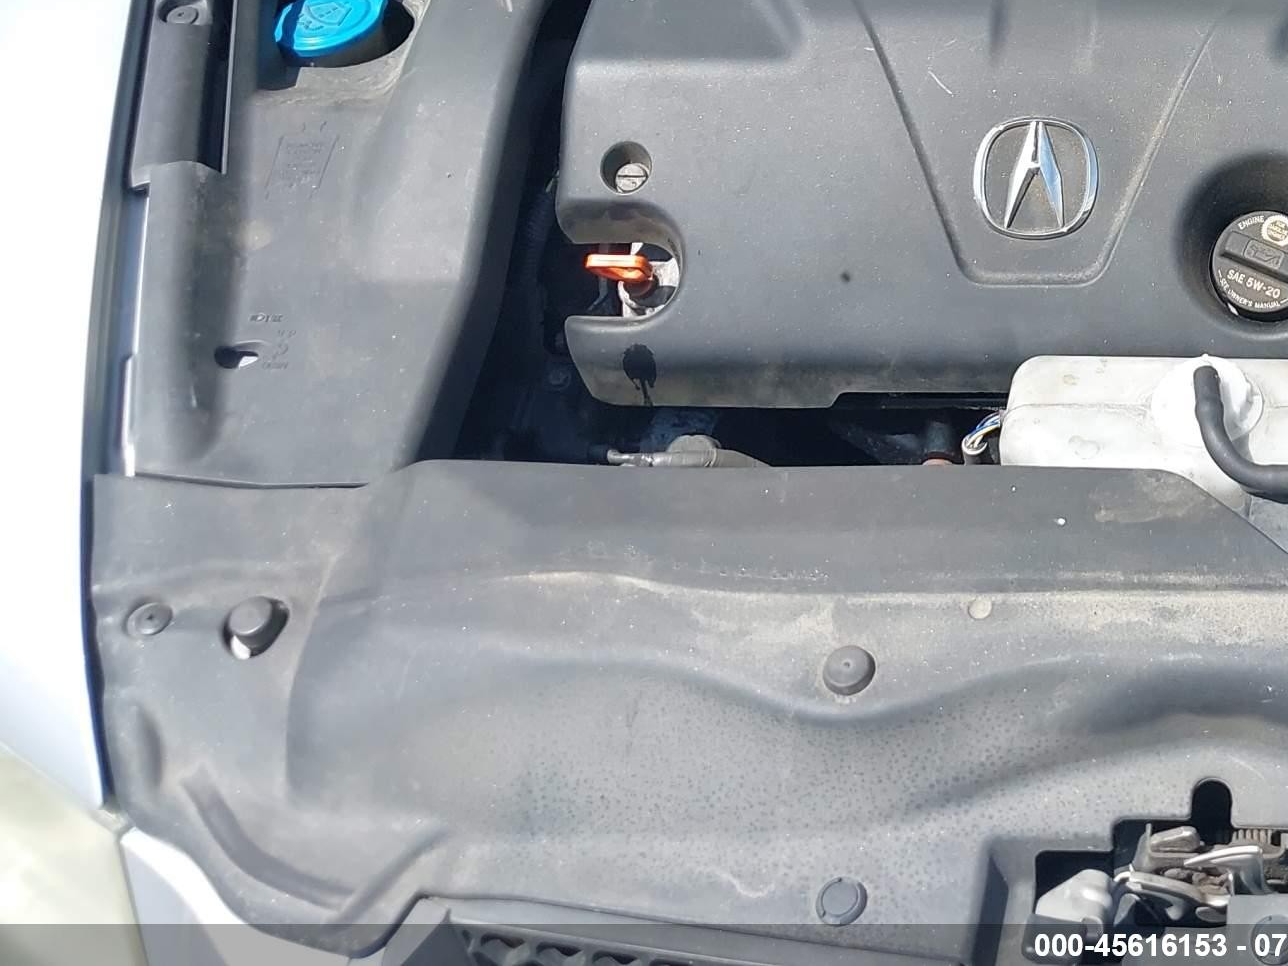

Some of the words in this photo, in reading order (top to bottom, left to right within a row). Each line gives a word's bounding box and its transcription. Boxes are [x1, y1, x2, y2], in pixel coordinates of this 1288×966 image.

[1238, 215, 1265, 230] ENGINE
[1227, 269, 1245, 284] SAE
[1246, 277, 1281, 298] 5W-20
[1228, 289, 1252, 307] OWNER'S
[1254, 300, 1280, 309] MANUAL
